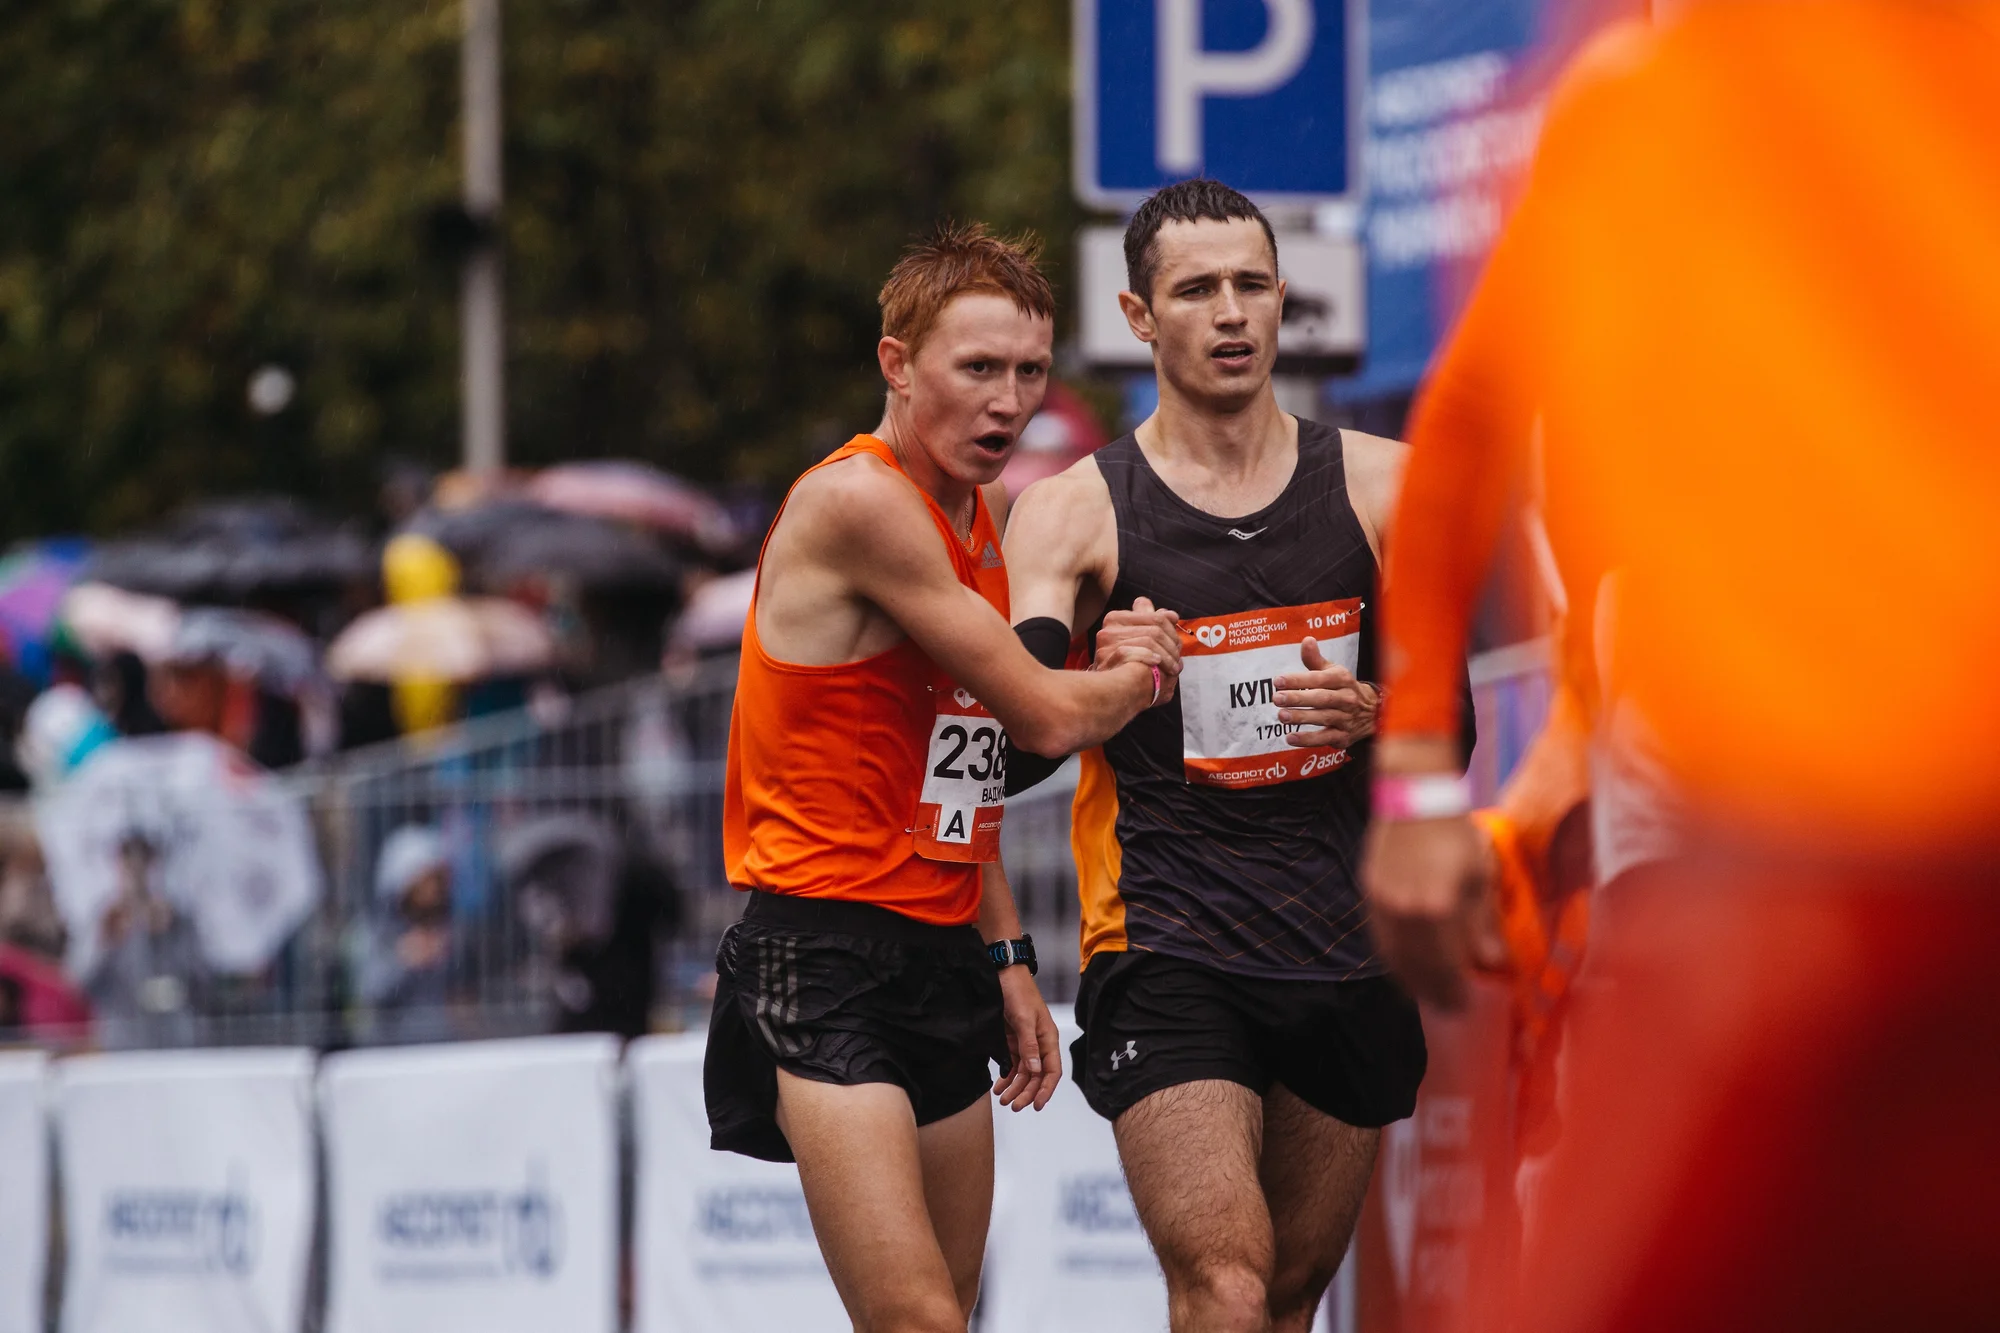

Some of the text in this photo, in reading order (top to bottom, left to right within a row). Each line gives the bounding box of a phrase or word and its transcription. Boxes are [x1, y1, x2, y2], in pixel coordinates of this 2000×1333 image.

[1228, 621, 1288, 637] МОСКОВСКИЙ
[1229, 617, 1268, 629] АБСОЛЮТ
[1307, 612, 1346, 630] 10 КМ
[1229, 633, 1270, 646] МАРАФОН
[1230, 678, 1279, 709] КУП
[933, 724, 1007, 782] 238
[1317, 750, 1346, 769] asics
[1208, 768, 1264, 780] АБСОЛЮТ
